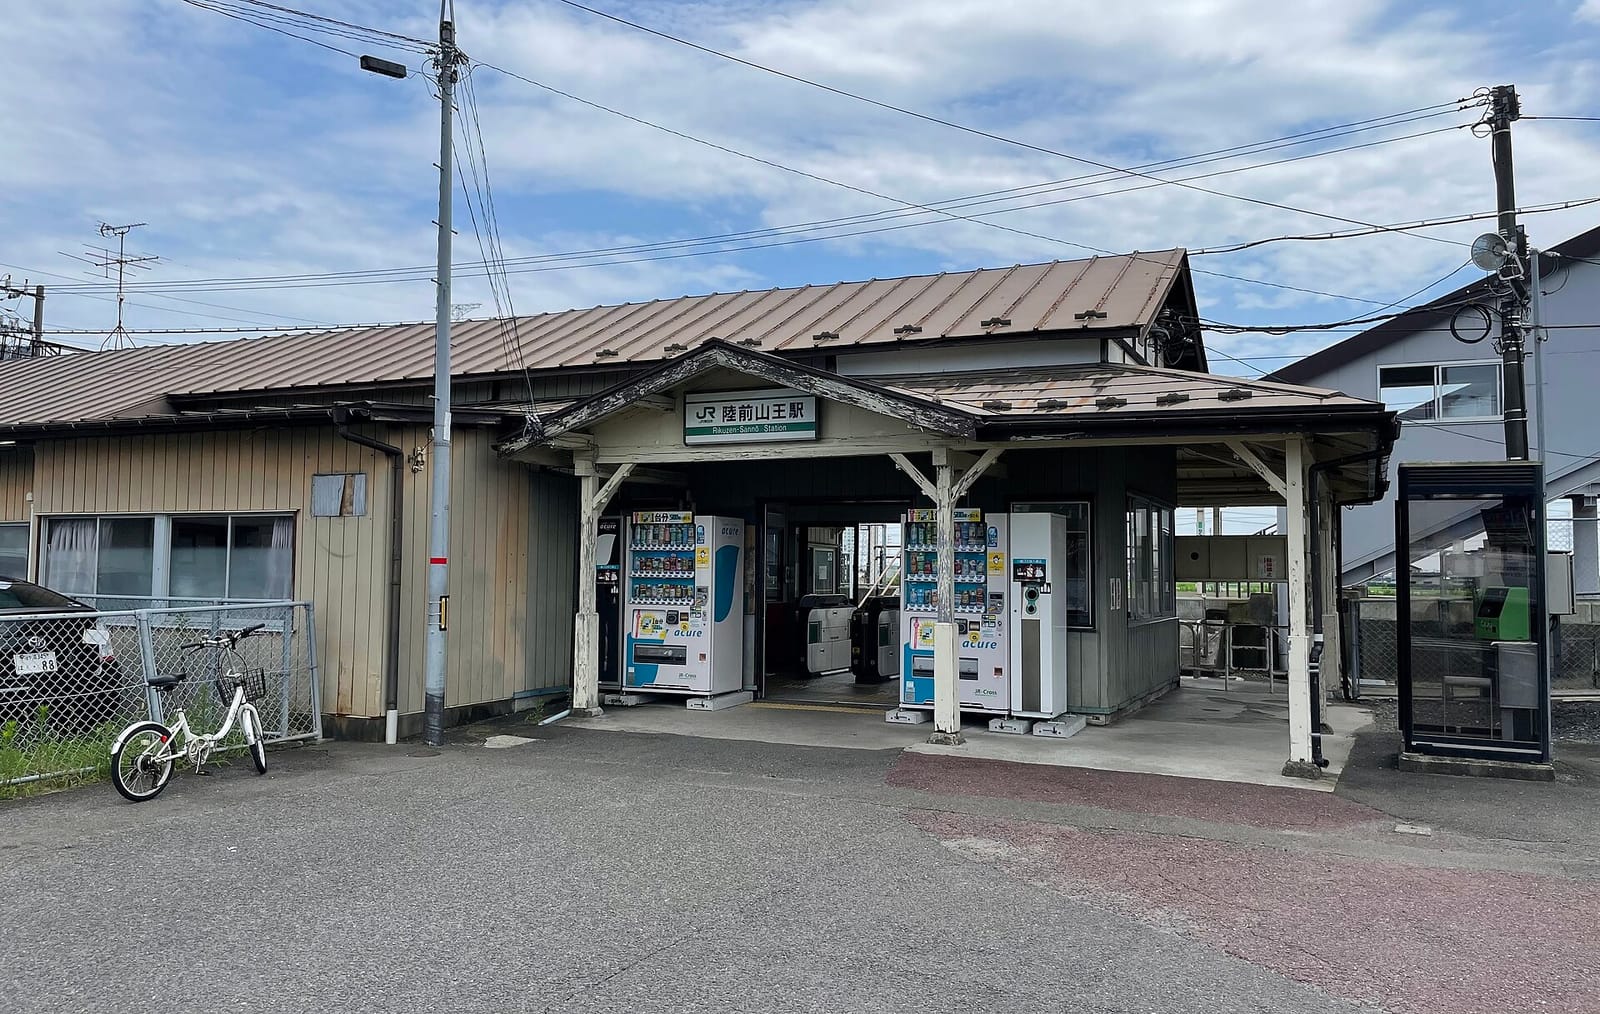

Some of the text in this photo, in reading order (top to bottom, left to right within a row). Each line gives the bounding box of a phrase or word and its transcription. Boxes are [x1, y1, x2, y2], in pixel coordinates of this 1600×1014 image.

[696, 402, 804, 423] JR 陸前山王駅
[763, 424, 787, 432] Station
[721, 527, 739, 535] acure
[674, 629, 703, 637] acure
[962, 640, 997, 649] acure
[42, 660, 54, 670] 88
